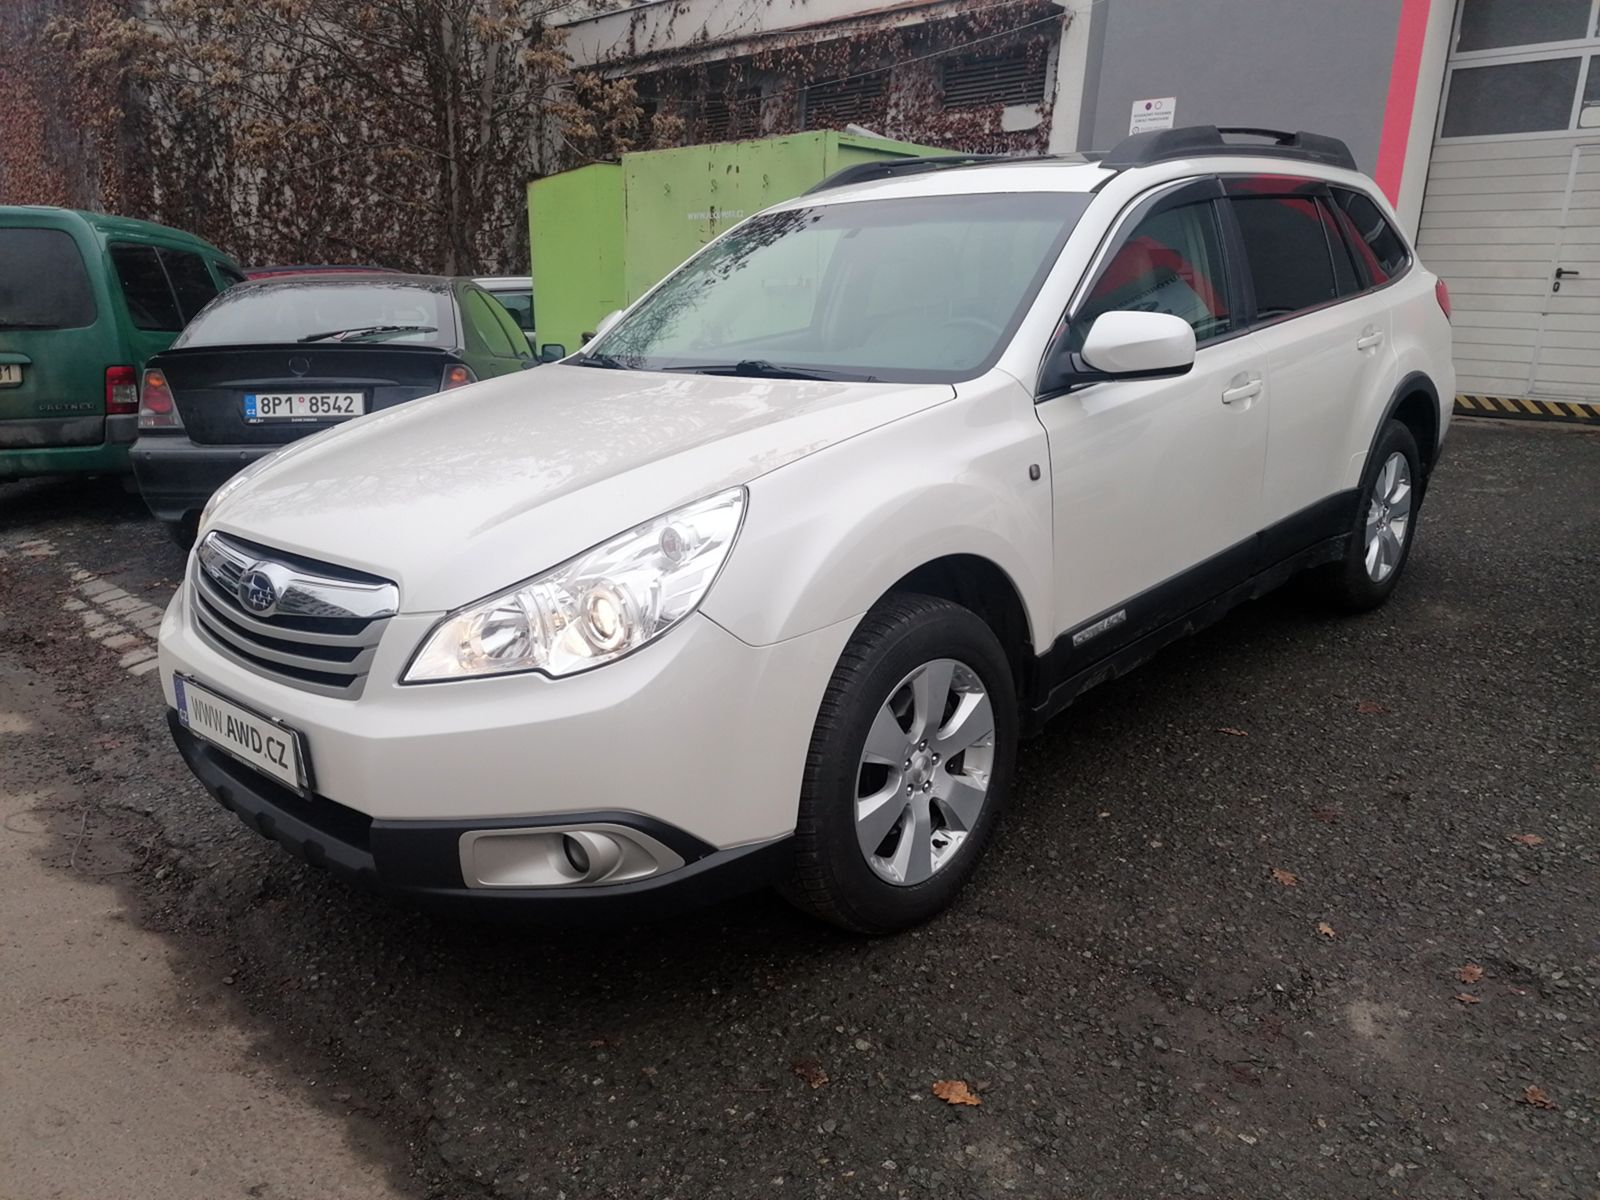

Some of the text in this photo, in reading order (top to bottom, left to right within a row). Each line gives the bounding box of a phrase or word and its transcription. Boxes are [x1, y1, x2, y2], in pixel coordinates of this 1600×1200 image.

[261, 396, 354, 414] 8P1 8542
[179, 708, 188, 722] CZ
[191, 695, 288, 770] WWW.AWD.CZ
